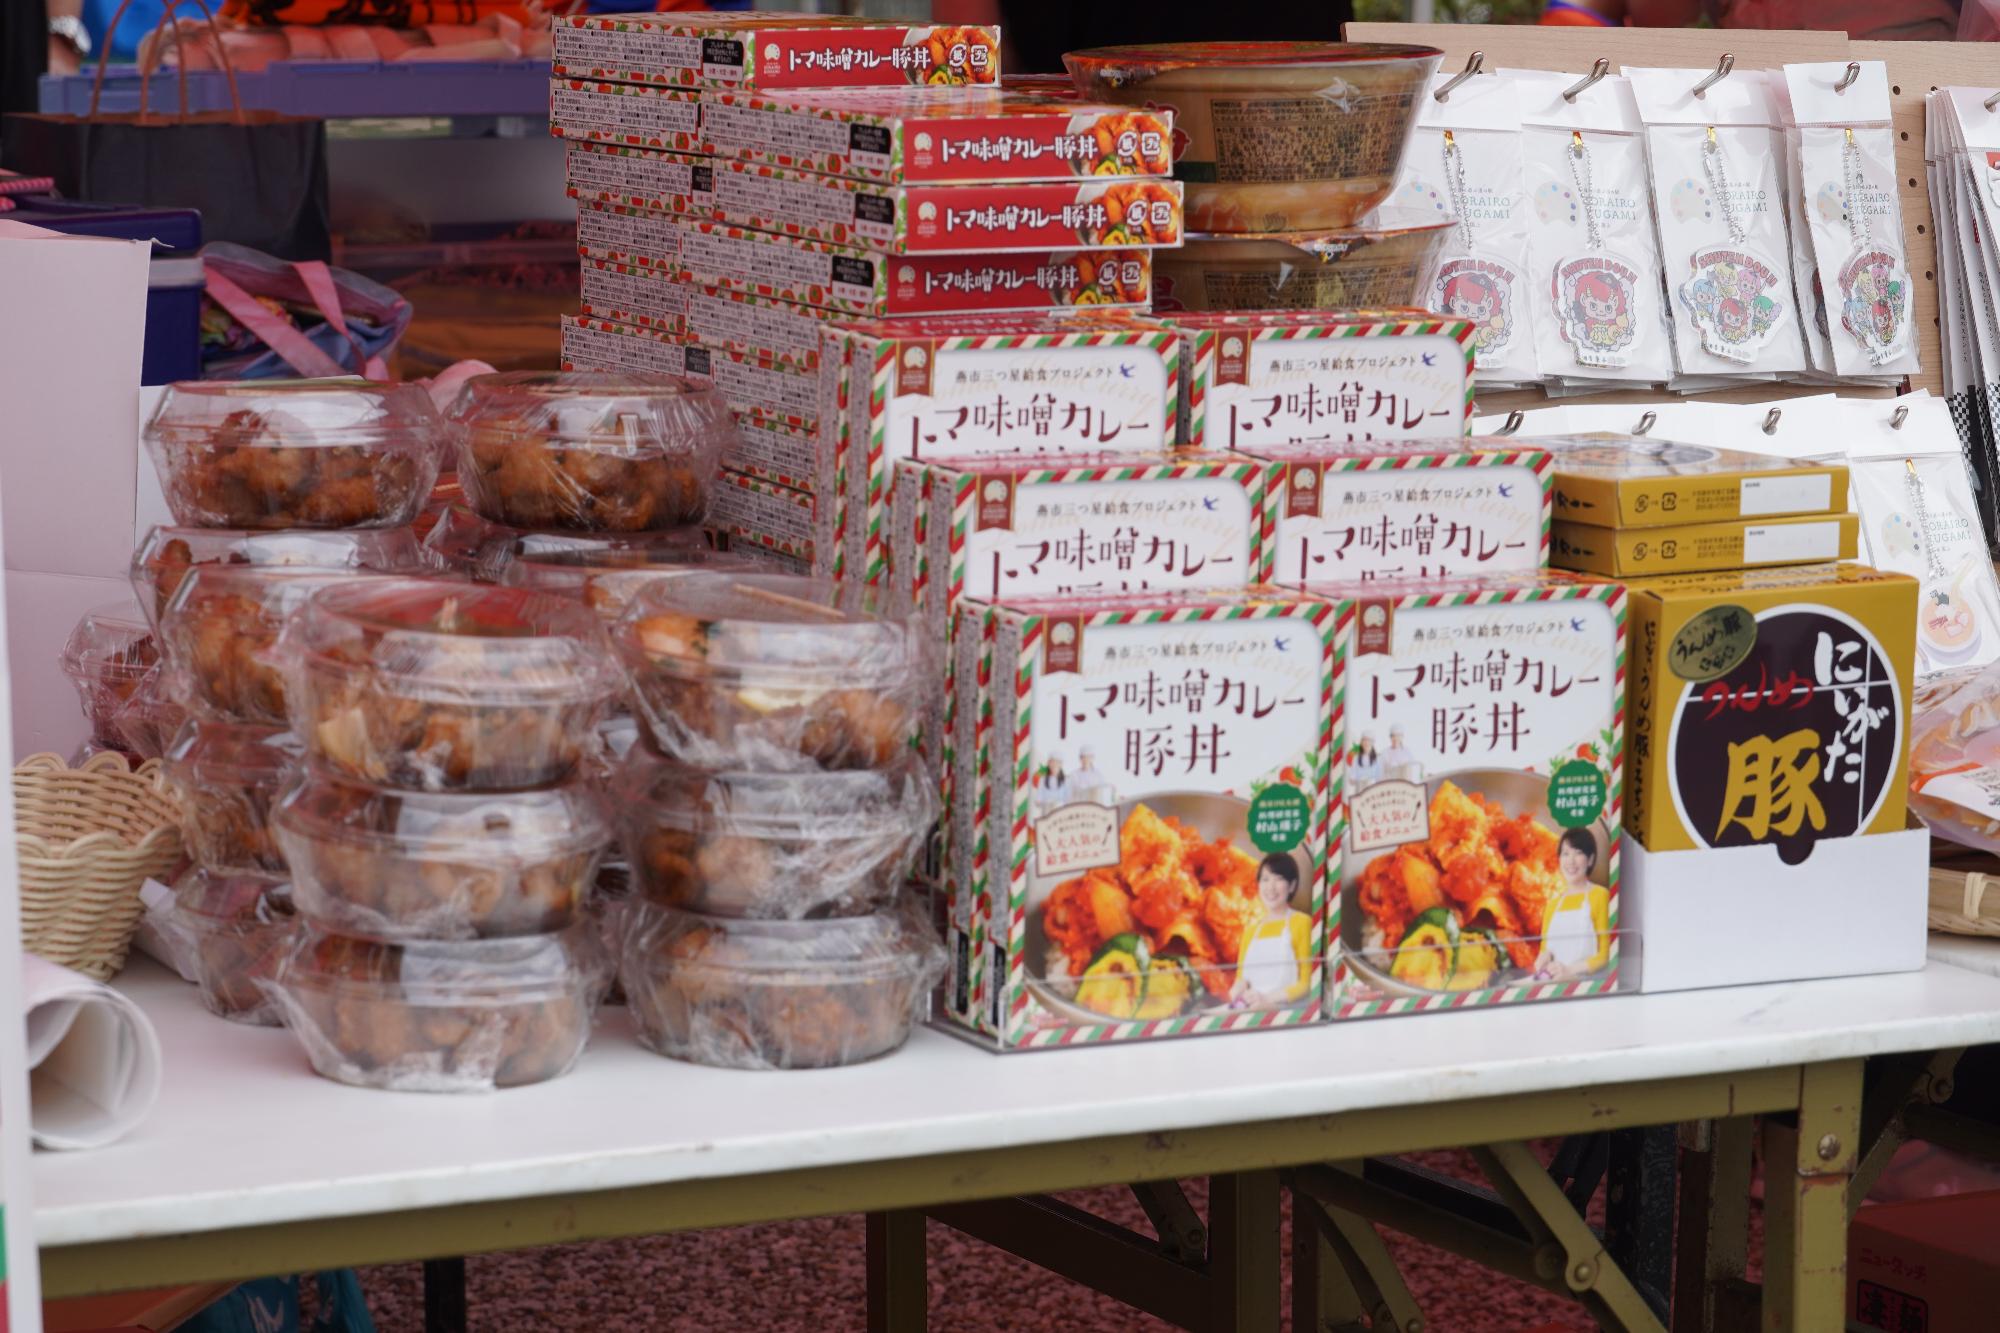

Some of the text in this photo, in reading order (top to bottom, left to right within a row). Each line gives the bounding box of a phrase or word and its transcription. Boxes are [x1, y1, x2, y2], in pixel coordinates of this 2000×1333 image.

[789, 47, 931, 71] トマ味噌カレー豚丼
[942, 136, 1098, 161] トマ味噌カレー豚丼
[946, 206, 1107, 231] トマ味噌カレー豚丼
[1595, 209, 1636, 220] UGAMI
[925, 264, 1079, 294] トマ味噌カレー豚丼
[911, 392, 1149, 460] トマ味噌カレー
[1229, 381, 1450, 448] トマ味噌カレー
[993, 526, 1234, 596] トマ味噌カレー
[1301, 513, 1526, 580] トマ味噌カレー
[1060, 668, 1305, 740] トマ味噌カレー
[1372, 648, 1600, 719] トマ味噌カレー
[1813, 631, 1890, 784] にいがた
[1125, 723, 1231, 776] 豚丼
[1431, 701, 1531, 755] 豚丼
[1714, 728, 1827, 842] 豚
